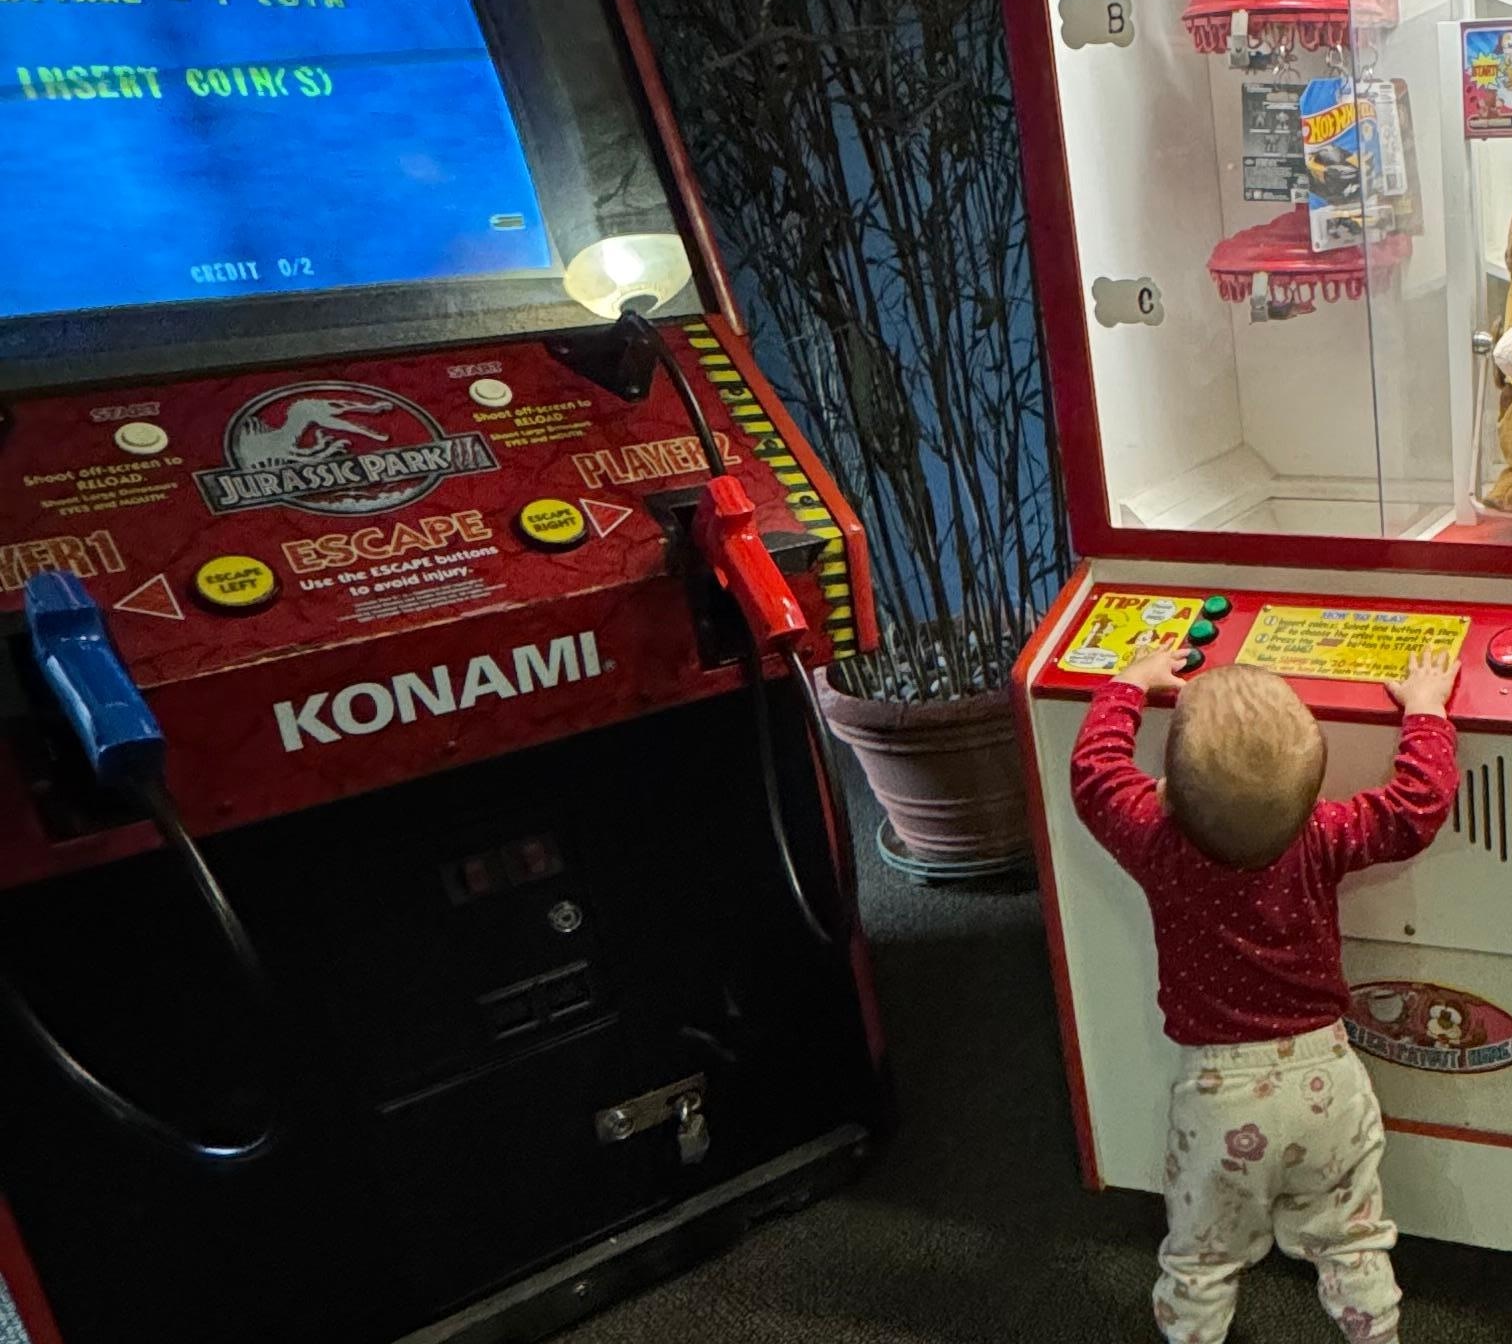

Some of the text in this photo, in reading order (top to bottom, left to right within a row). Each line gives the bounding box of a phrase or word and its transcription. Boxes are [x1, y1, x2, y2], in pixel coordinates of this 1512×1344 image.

[1108, 2, 1125, 34] B
[17, 65, 333, 100] INSERT COIN(S)
[190, 257, 315, 283] CREDIT 0/2
[1138, 287, 1155, 315] C
[473, 410, 512, 423] Shoot
[577, 399, 592, 408] to
[23, 456, 184, 487] Shoot off-screen to
[217, 458, 363, 505] JURASSIC
[359, 446, 451, 484] PARK
[572, 435, 710, 489] PLAYER
[526, 507, 572, 524] ESCAPE
[534, 516, 578, 533] RIGHT
[281, 511, 493, 575] ESCAPE
[206, 564, 264, 585] ESCAPE
[300, 545, 500, 592] Use the ESCAPE buttons
[350, 565, 475, 597] to avoid injury.
[219, 578, 259, 594] LEFT
[273, 630, 603, 753] KONAMI
